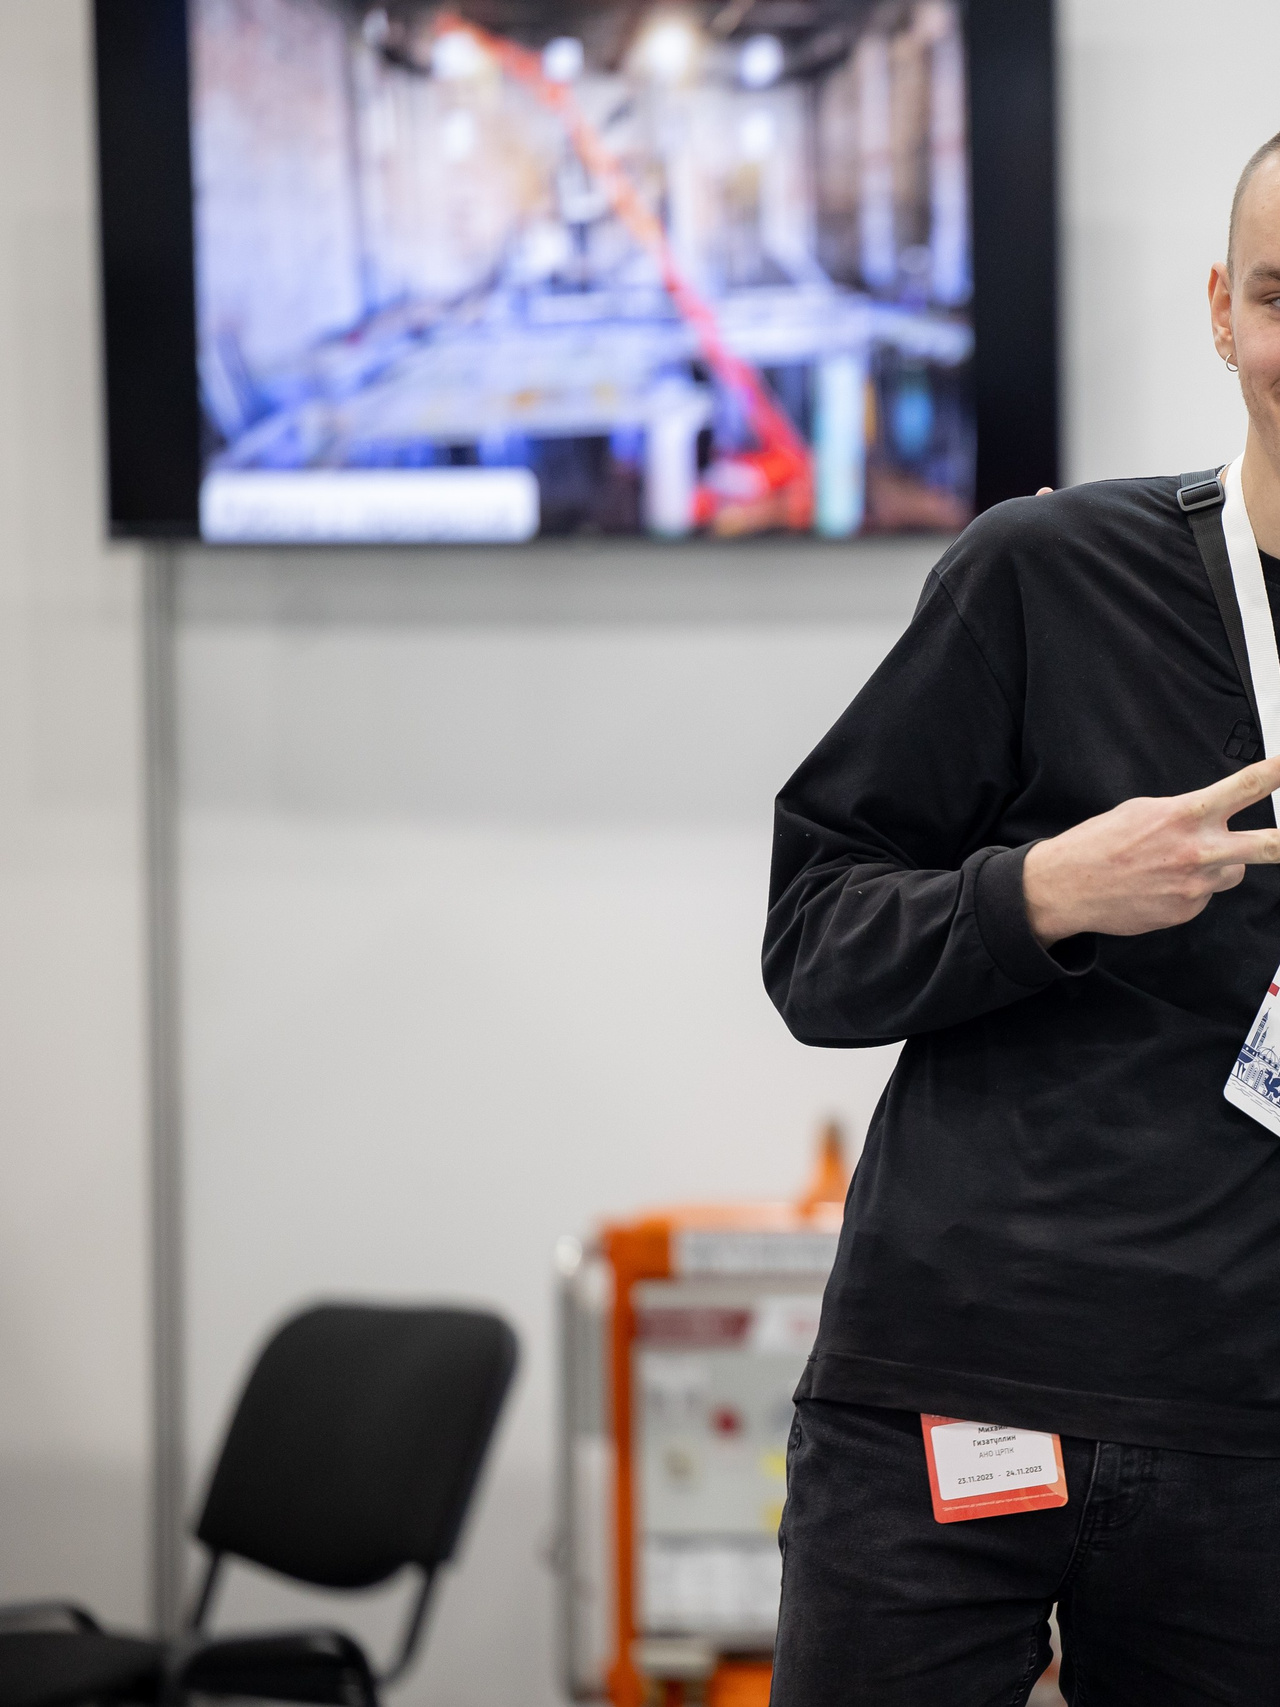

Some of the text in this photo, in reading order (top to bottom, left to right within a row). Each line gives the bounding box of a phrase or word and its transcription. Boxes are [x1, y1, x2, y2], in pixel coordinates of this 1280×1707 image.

[972, 1435, 1016, 1447] Гизатуллин
[979, 1450, 993, 1459] АНО
[957, 1473, 994, 1485] 23.11.2023
[1006, 1465, 1042, 1477] 24.11.2023
